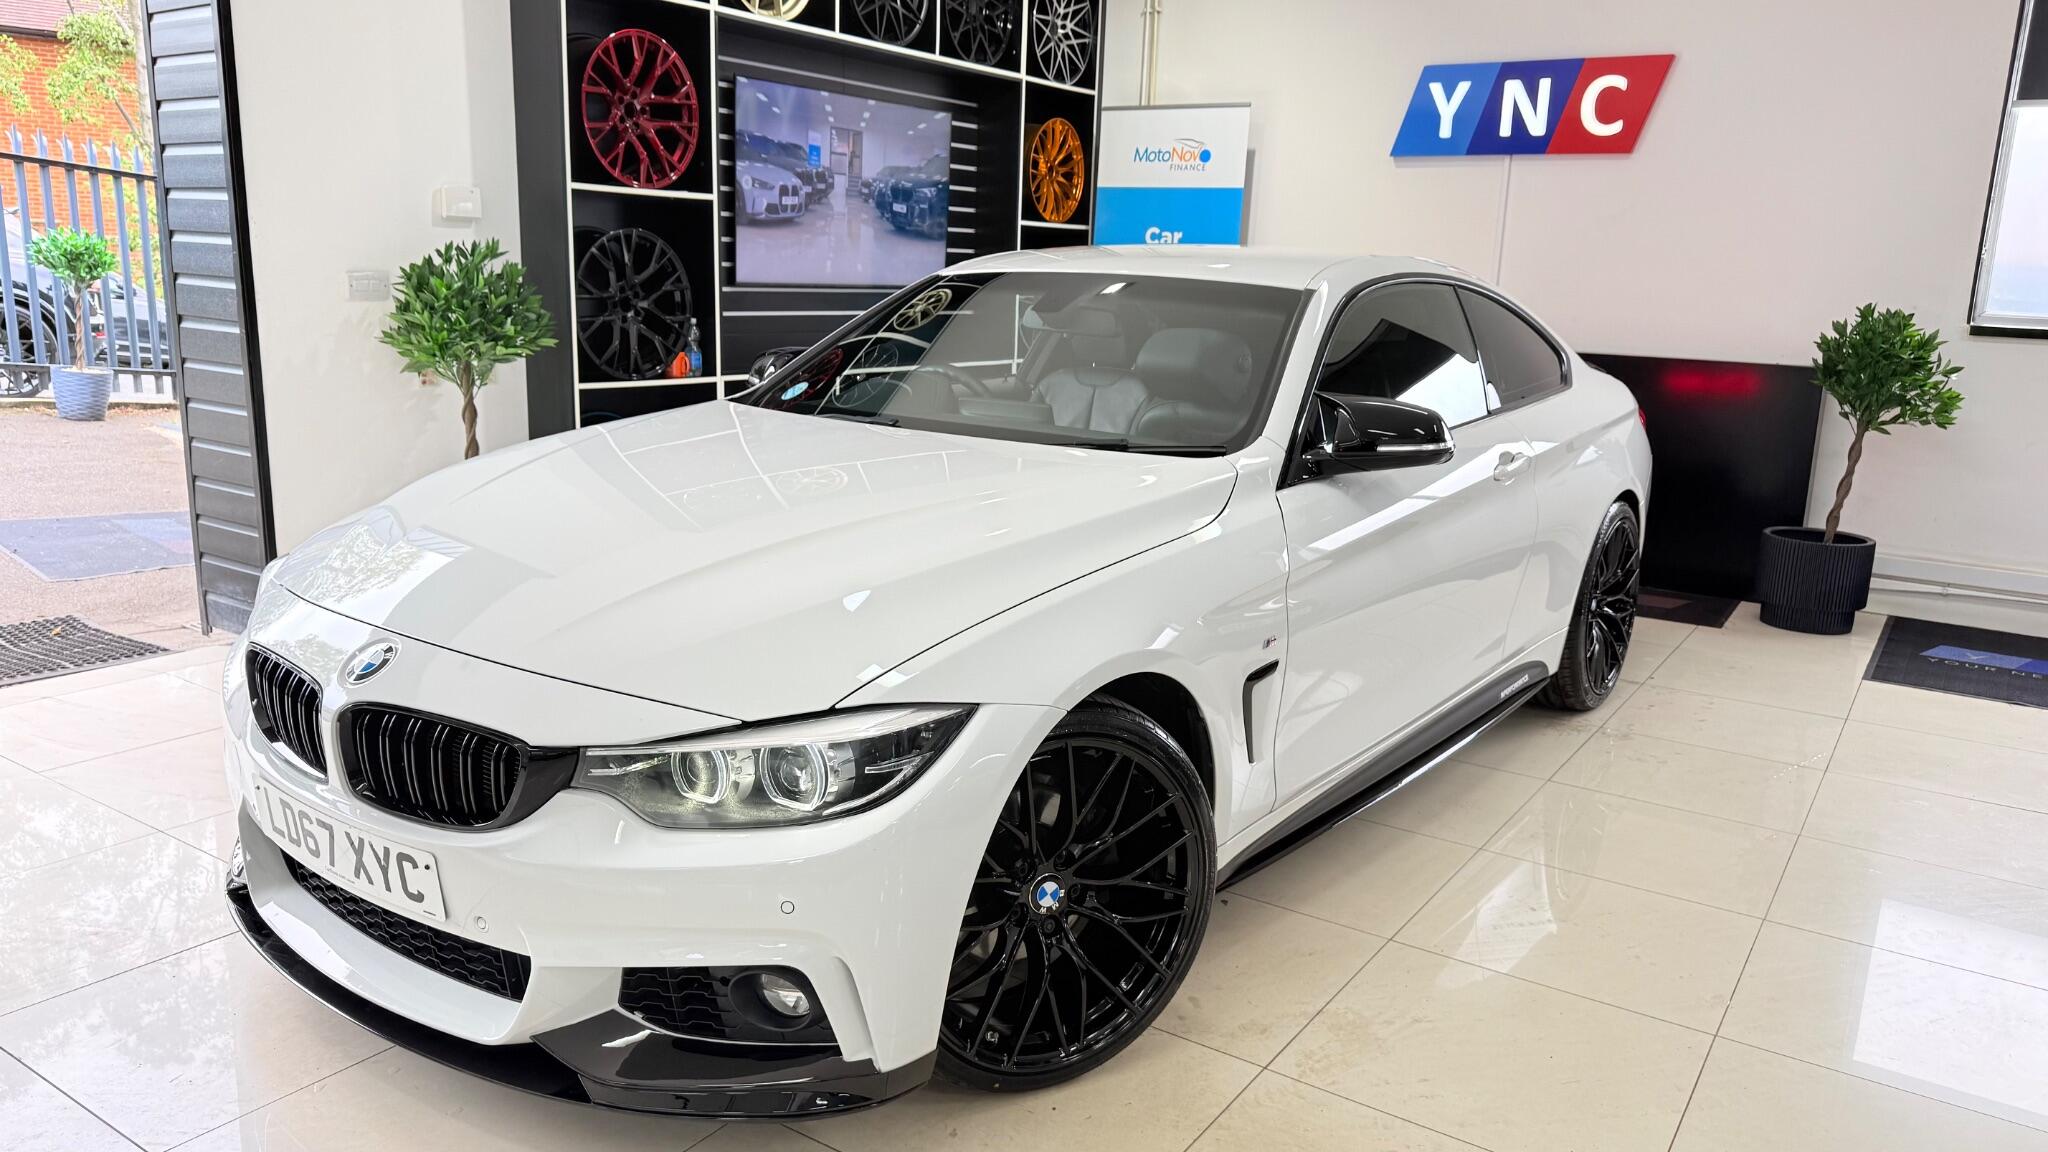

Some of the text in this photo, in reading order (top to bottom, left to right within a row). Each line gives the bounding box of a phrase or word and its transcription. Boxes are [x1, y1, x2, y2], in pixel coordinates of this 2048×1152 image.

[1169, 163, 1207, 172] FINANCE
[1145, 226, 1184, 244] Car
[1927, 656, 1997, 672] YOUR
[263, 786, 425, 904] LD67 XYC
